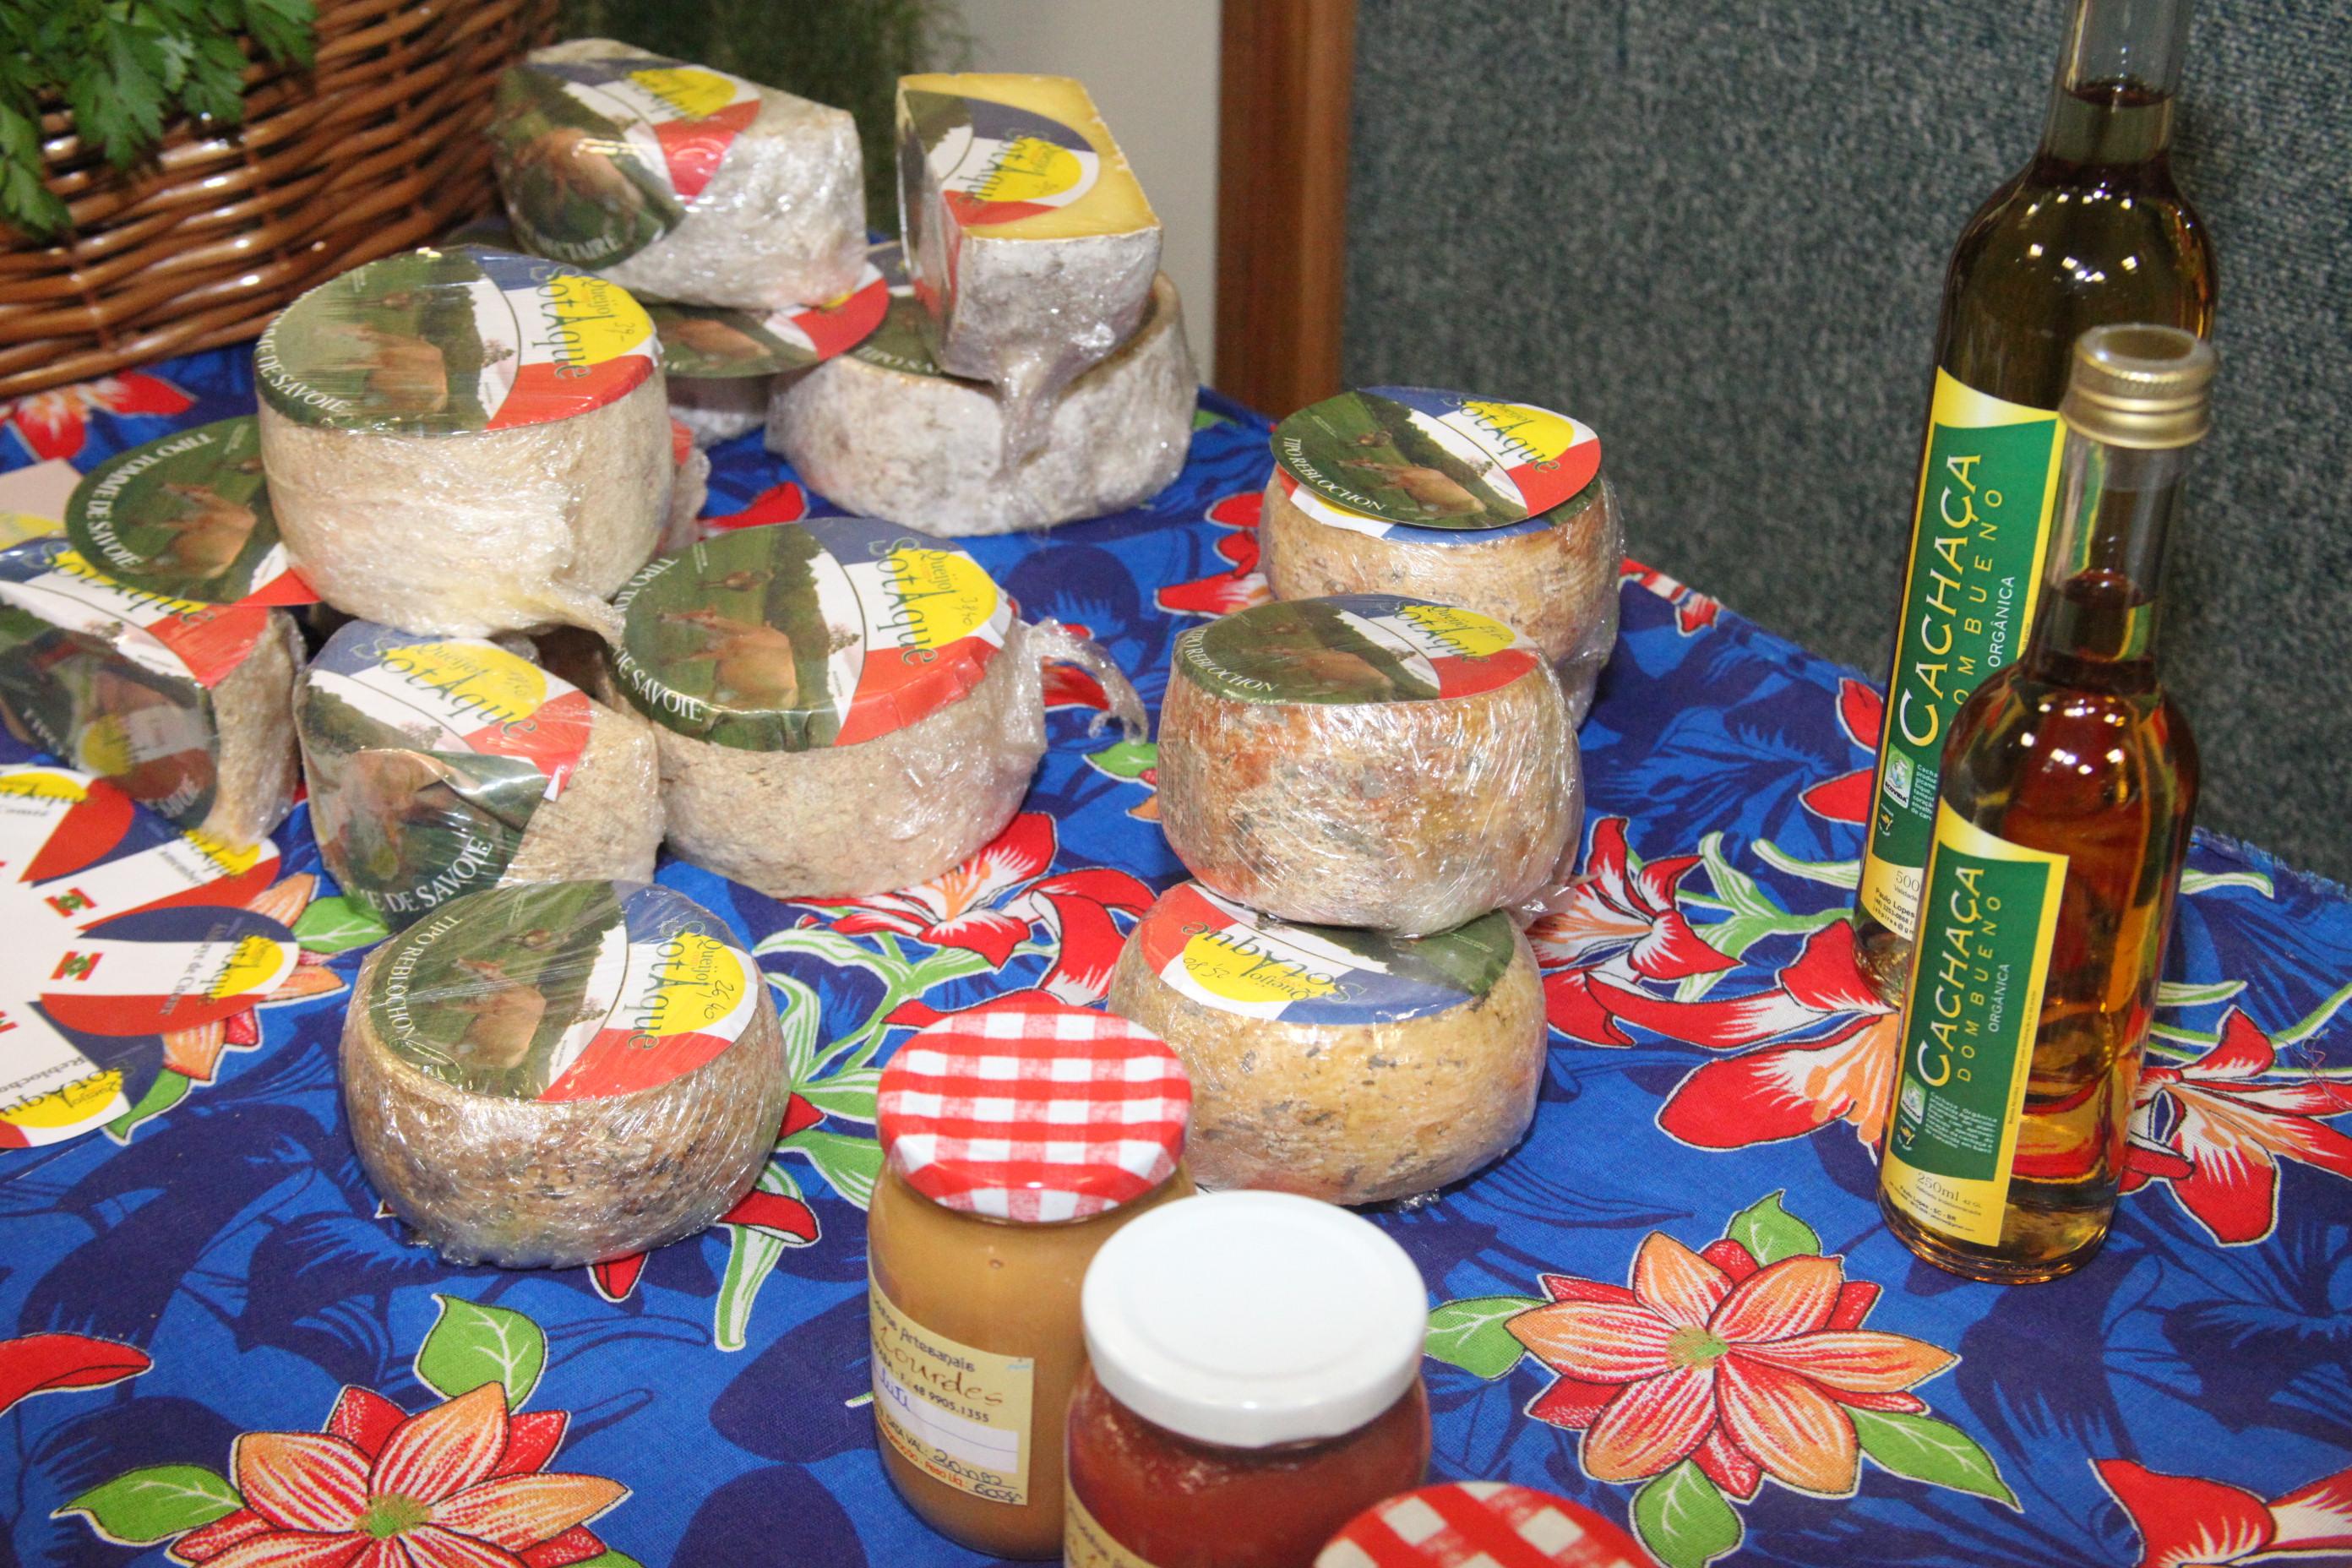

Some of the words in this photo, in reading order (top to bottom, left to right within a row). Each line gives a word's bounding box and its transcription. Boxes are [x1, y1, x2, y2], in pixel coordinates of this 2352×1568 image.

[530, 264, 622, 379] SotAque
[269, 373, 353, 413] SAVOIE
[1439, 395, 1560, 474] SotAque
[1288, 457, 1387, 511] REBLOCHON
[1963, 488, 2004, 635] BUENO
[868, 536, 960, 666] SotAque
[1379, 599, 1490, 665] SotAque
[1899, 454, 1981, 748] CACHAÇA
[1987, 575, 2016, 668] ORGÂNICA
[348, 637, 538, 738] SotAque
[632, 668, 704, 723] SAVOIE
[1184, 647, 1280, 692] REBLOCHON
[1950, 655, 1977, 727] OM
[1917, 763, 1939, 779] Cacha
[384, 890, 420, 913] DE
[415, 835, 494, 909] SAVOIE
[1875, 887, 1892, 905] Paulo
[1892, 901, 1916, 918] Lopes
[1895, 870, 1921, 892] 500
[414, 915, 464, 945] TIPO
[690, 938, 725, 981] Queijo
[1182, 921, 1368, 1005] SotAque
[384, 945, 425, 1041] REBLOCHON
[623, 919, 715, 1050] SotAque
[1250, 972, 1317, 1002] Queijo
[1917, 865, 1984, 1087] CACHAÇA
[1957, 1019, 1981, 1082] DOM
[1969, 896, 2001, 1006] BUENO
[0, 1055, 88, 1093] Reblocho
[0, 1059, 136, 1117] SotAqu
[1917, 1172, 1960, 1202] 250ml
[912, 1384, 927, 1397] 48
[928, 1391, 990, 1424] 9905.1355
